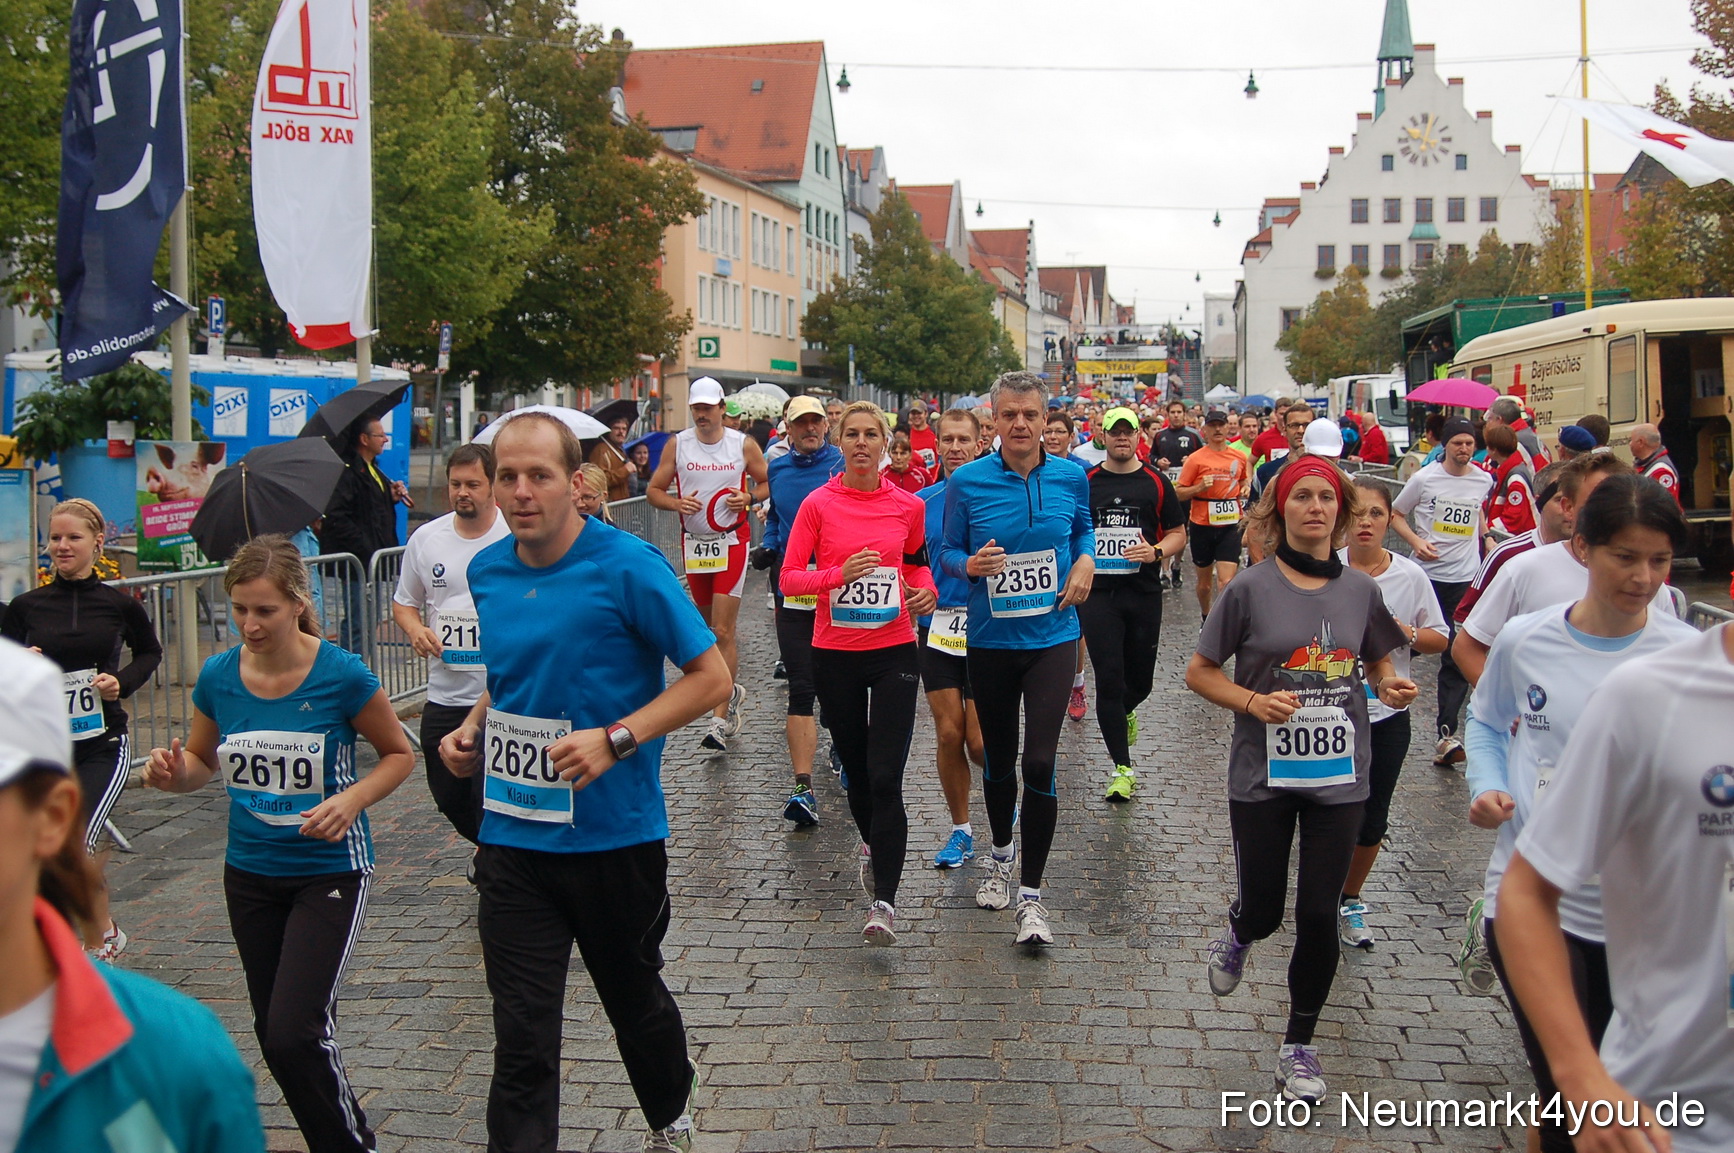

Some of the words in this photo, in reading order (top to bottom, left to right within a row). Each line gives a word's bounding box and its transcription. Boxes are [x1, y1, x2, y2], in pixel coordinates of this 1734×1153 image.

[212, 303, 222, 330] P
[1106, 363, 1136, 371] START
[1531, 355, 1581, 381] Bayerisches
[1531, 384, 1554, 402] Rotes
[686, 462, 735, 471] Oberbank
[1215, 501, 1235, 513] 503
[1106, 514, 1129, 526] 12811
[1443, 507, 1471, 524] 268
[1442, 525, 1466, 535] Michael
[694, 542, 720, 557] 476
[1011, 557, 1044, 567] Neumarkt
[994, 566, 1052, 594] 2356
[836, 581, 892, 606] 2357
[1005, 596, 1044, 609] Berthold
[457, 615, 479, 623] Neuma
[849, 610, 881, 620] Sandra
[442, 624, 477, 647] 211
[64, 678, 85, 687] markt
[1282, 688, 1322, 696] gensburg
[1323, 685, 1351, 694] Marathon
[65, 686, 94, 714] 76
[1305, 695, 1325, 706] Mai
[1297, 714, 1339, 723] Neumarkt
[1524, 713, 1550, 725] PARTL
[71, 720, 89, 731] ska
[487, 718, 507, 733] PARTL
[508, 724, 551, 740] Neumarkt
[255, 740, 304, 752] Neumarkt
[1275, 725, 1347, 756] 3088
[490, 735, 560, 783] 2620
[228, 752, 313, 790] 2619
[507, 785, 537, 806] Klaus
[249, 794, 293, 812] Sandra
[1698, 811, 1734, 826] PAR
[1699, 826, 1734, 837] Neum
